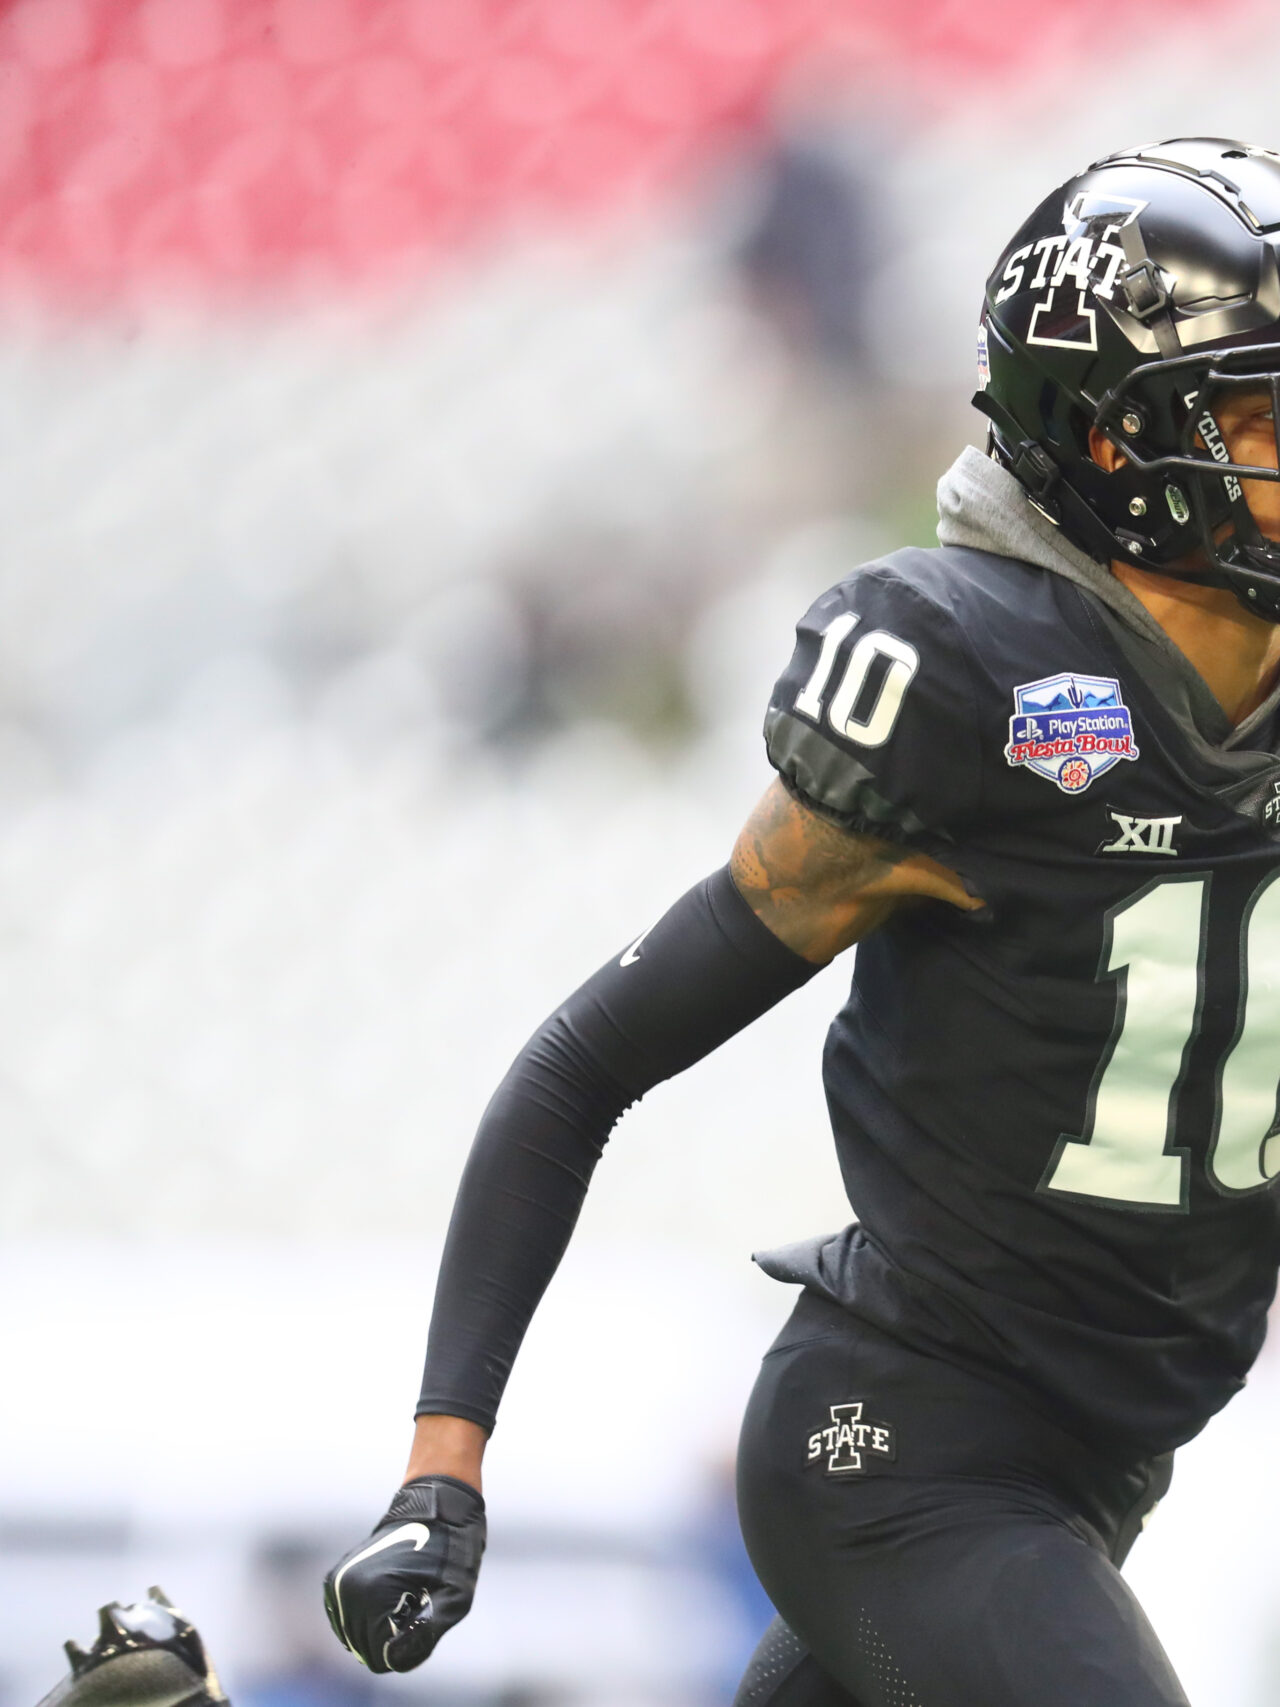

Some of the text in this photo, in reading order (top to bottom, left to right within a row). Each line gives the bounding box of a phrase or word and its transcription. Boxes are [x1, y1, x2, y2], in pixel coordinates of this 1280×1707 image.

[995, 235, 1165, 310] STAT
[1184, 391, 1242, 502] CCLOES
[793, 611, 920, 748] 10
[1010, 733, 1131, 761] Fiesta Bowl
[1048, 715, 1124, 738] PlayStation
[1102, 812, 1183, 857] XII
[807, 1424, 889, 1460] STATE
